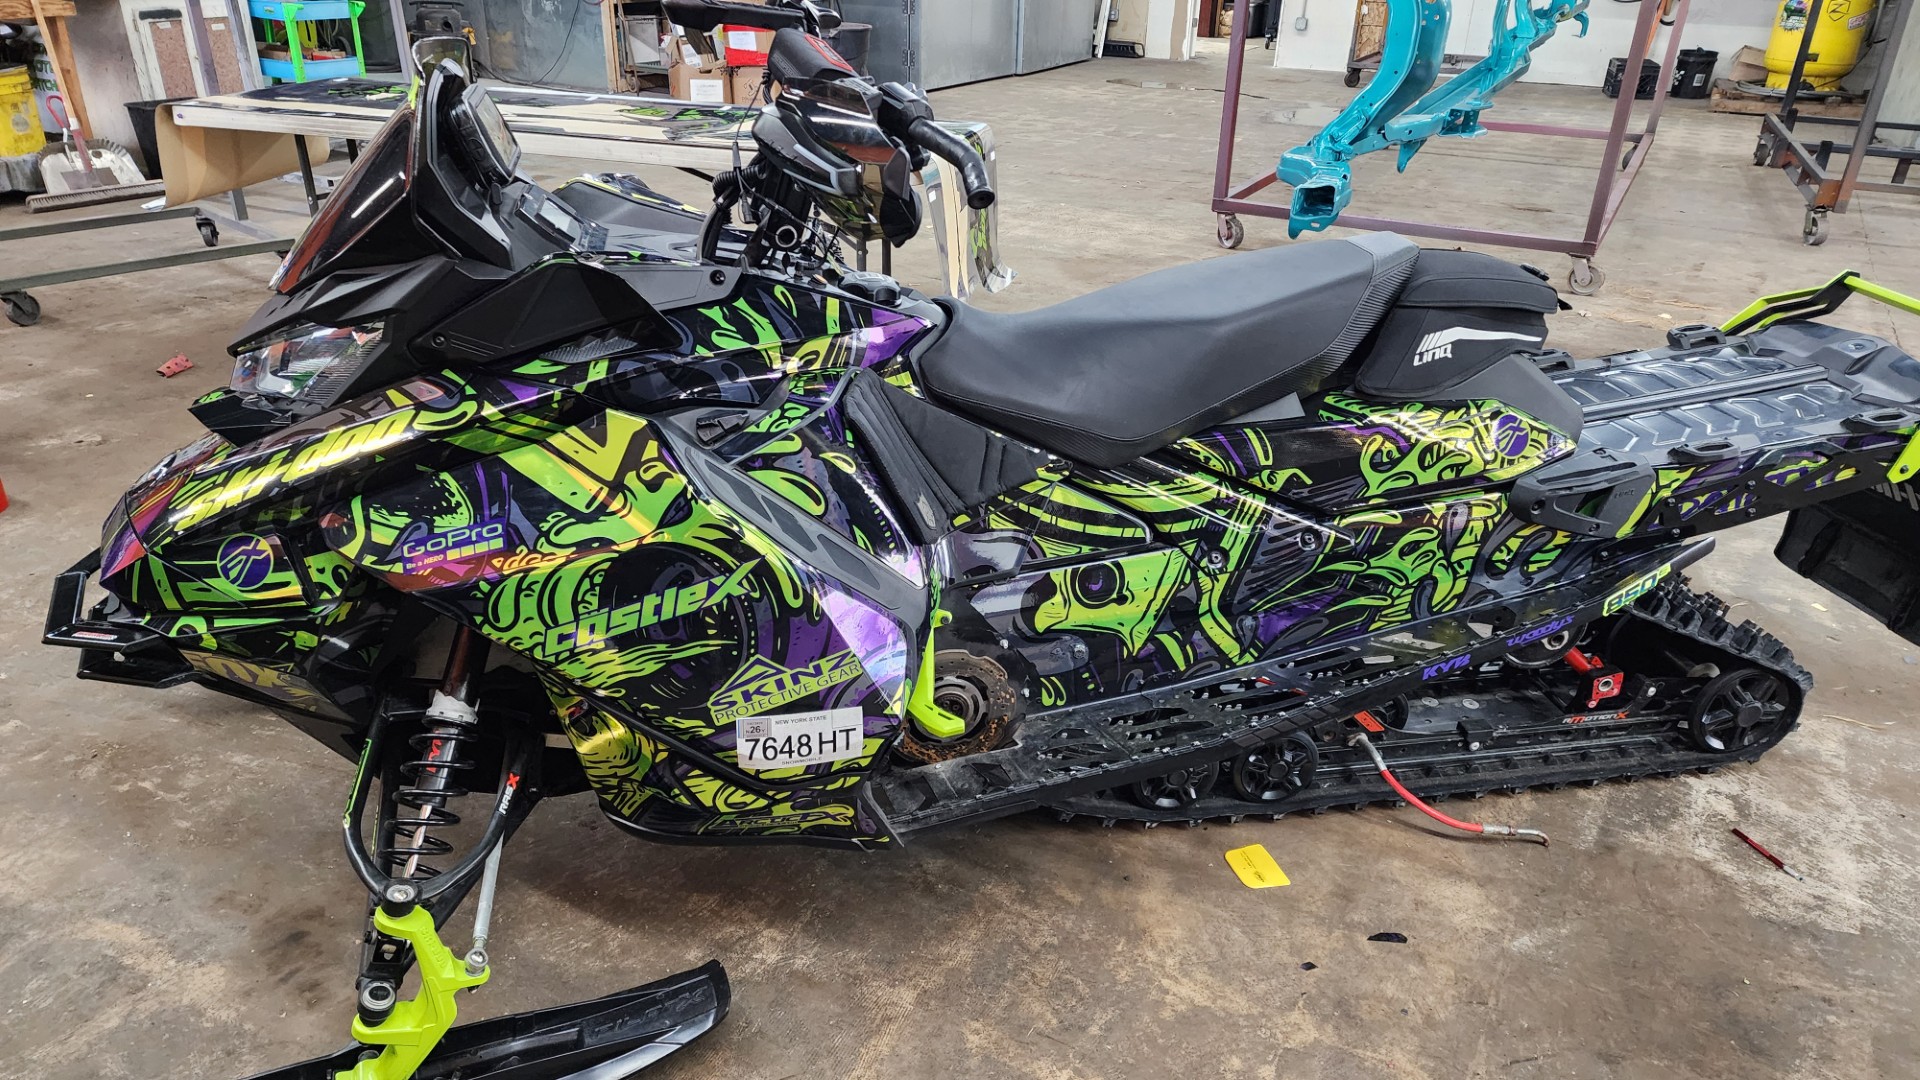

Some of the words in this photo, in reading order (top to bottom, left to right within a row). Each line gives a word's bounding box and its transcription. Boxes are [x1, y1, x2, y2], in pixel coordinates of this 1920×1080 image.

[403, 523, 503, 558] GoPro
[423, 554, 444, 566] HERO
[710, 651, 857, 713] SKINZ
[1422, 653, 1471, 681] KYB
[714, 683, 814, 724] PROTECTIVE
[816, 663, 860, 688] GEAR
[745, 733, 812, 761] 7648
[818, 728, 856, 755] HT
[750, 726, 761, 734] 26
[781, 756, 823, 766] SNOWMOBILE
